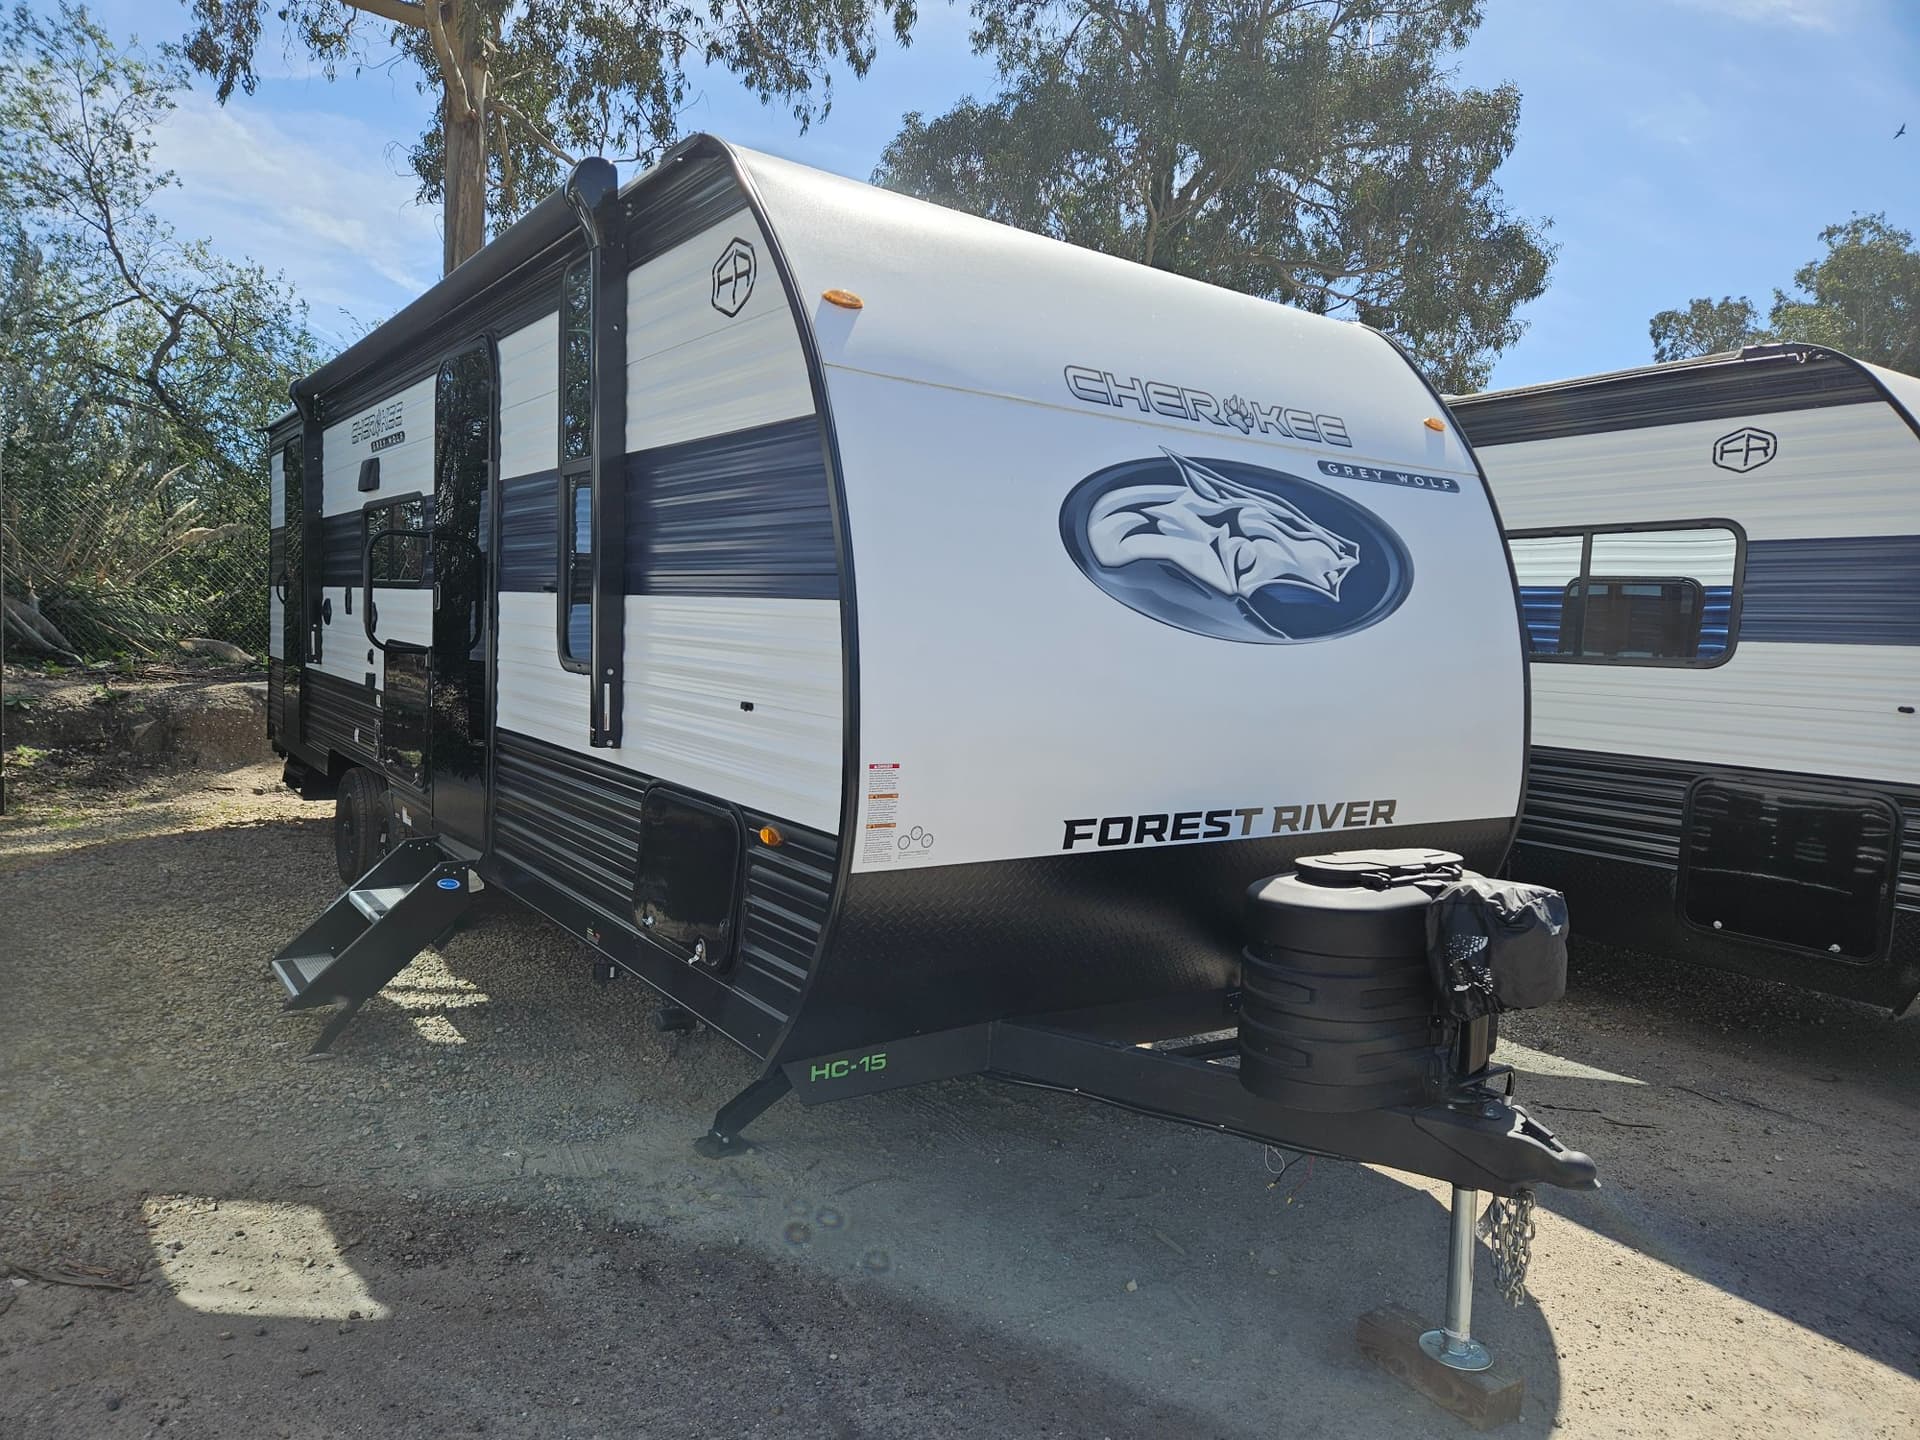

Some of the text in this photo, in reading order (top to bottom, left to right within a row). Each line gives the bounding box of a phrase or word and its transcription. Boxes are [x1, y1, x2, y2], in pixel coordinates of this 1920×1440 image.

[1327, 463, 1451, 489] GREY WOLF
[1062, 799, 1397, 850] FOREST RIVER
[810, 1052, 887, 1082] HC-15
